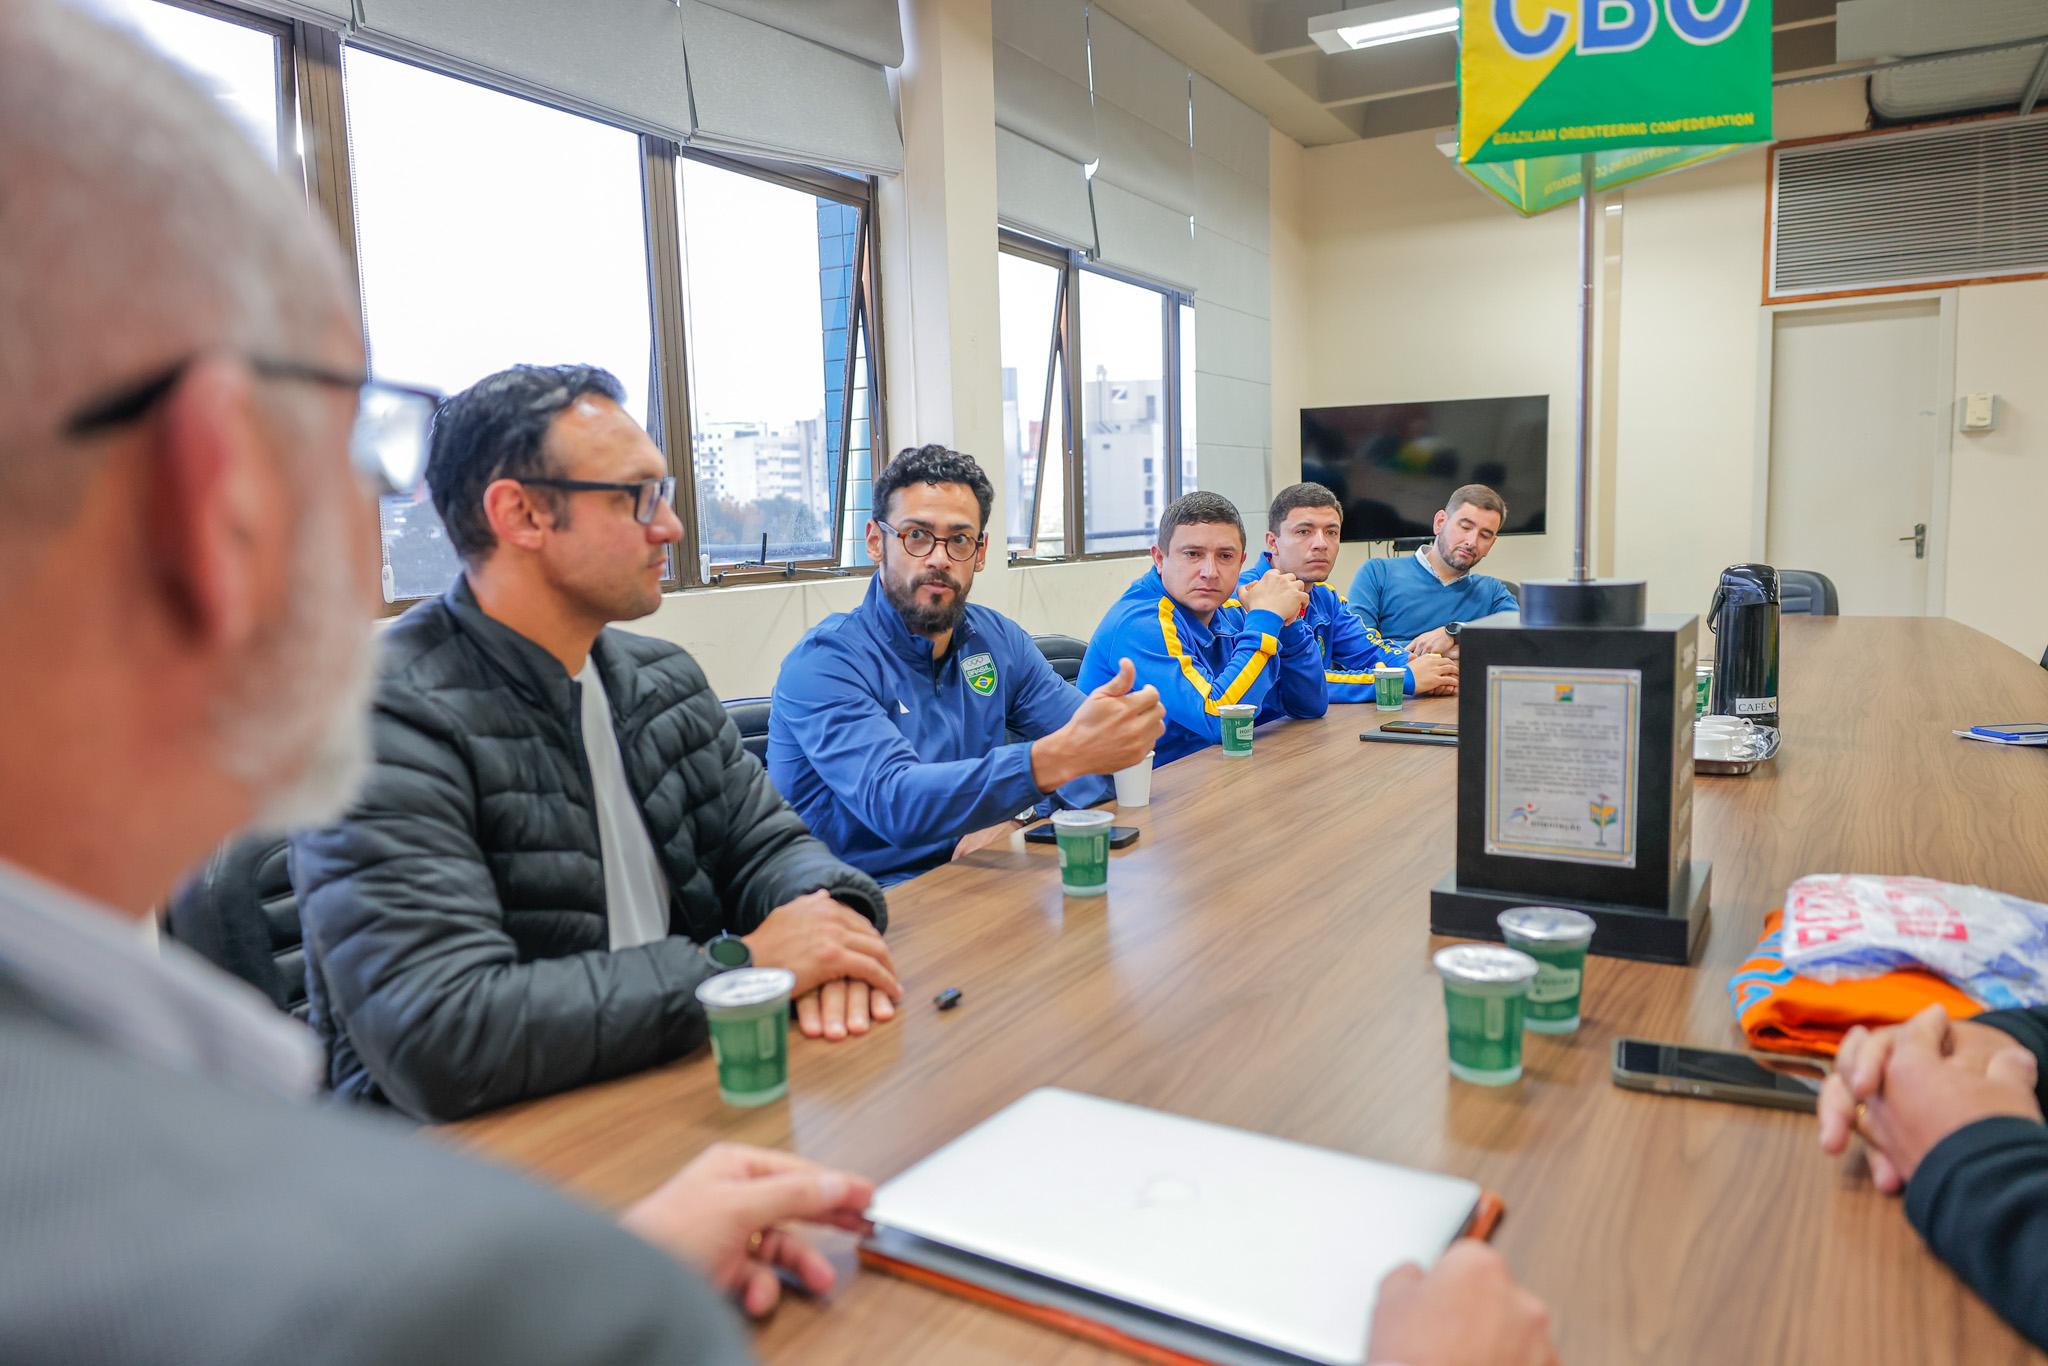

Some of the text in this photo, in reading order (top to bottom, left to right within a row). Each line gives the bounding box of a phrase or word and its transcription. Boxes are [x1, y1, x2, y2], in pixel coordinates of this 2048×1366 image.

[1493, 112, 1755, 145] BRAZILIAN ORIENTEERING CONFEDERATION
